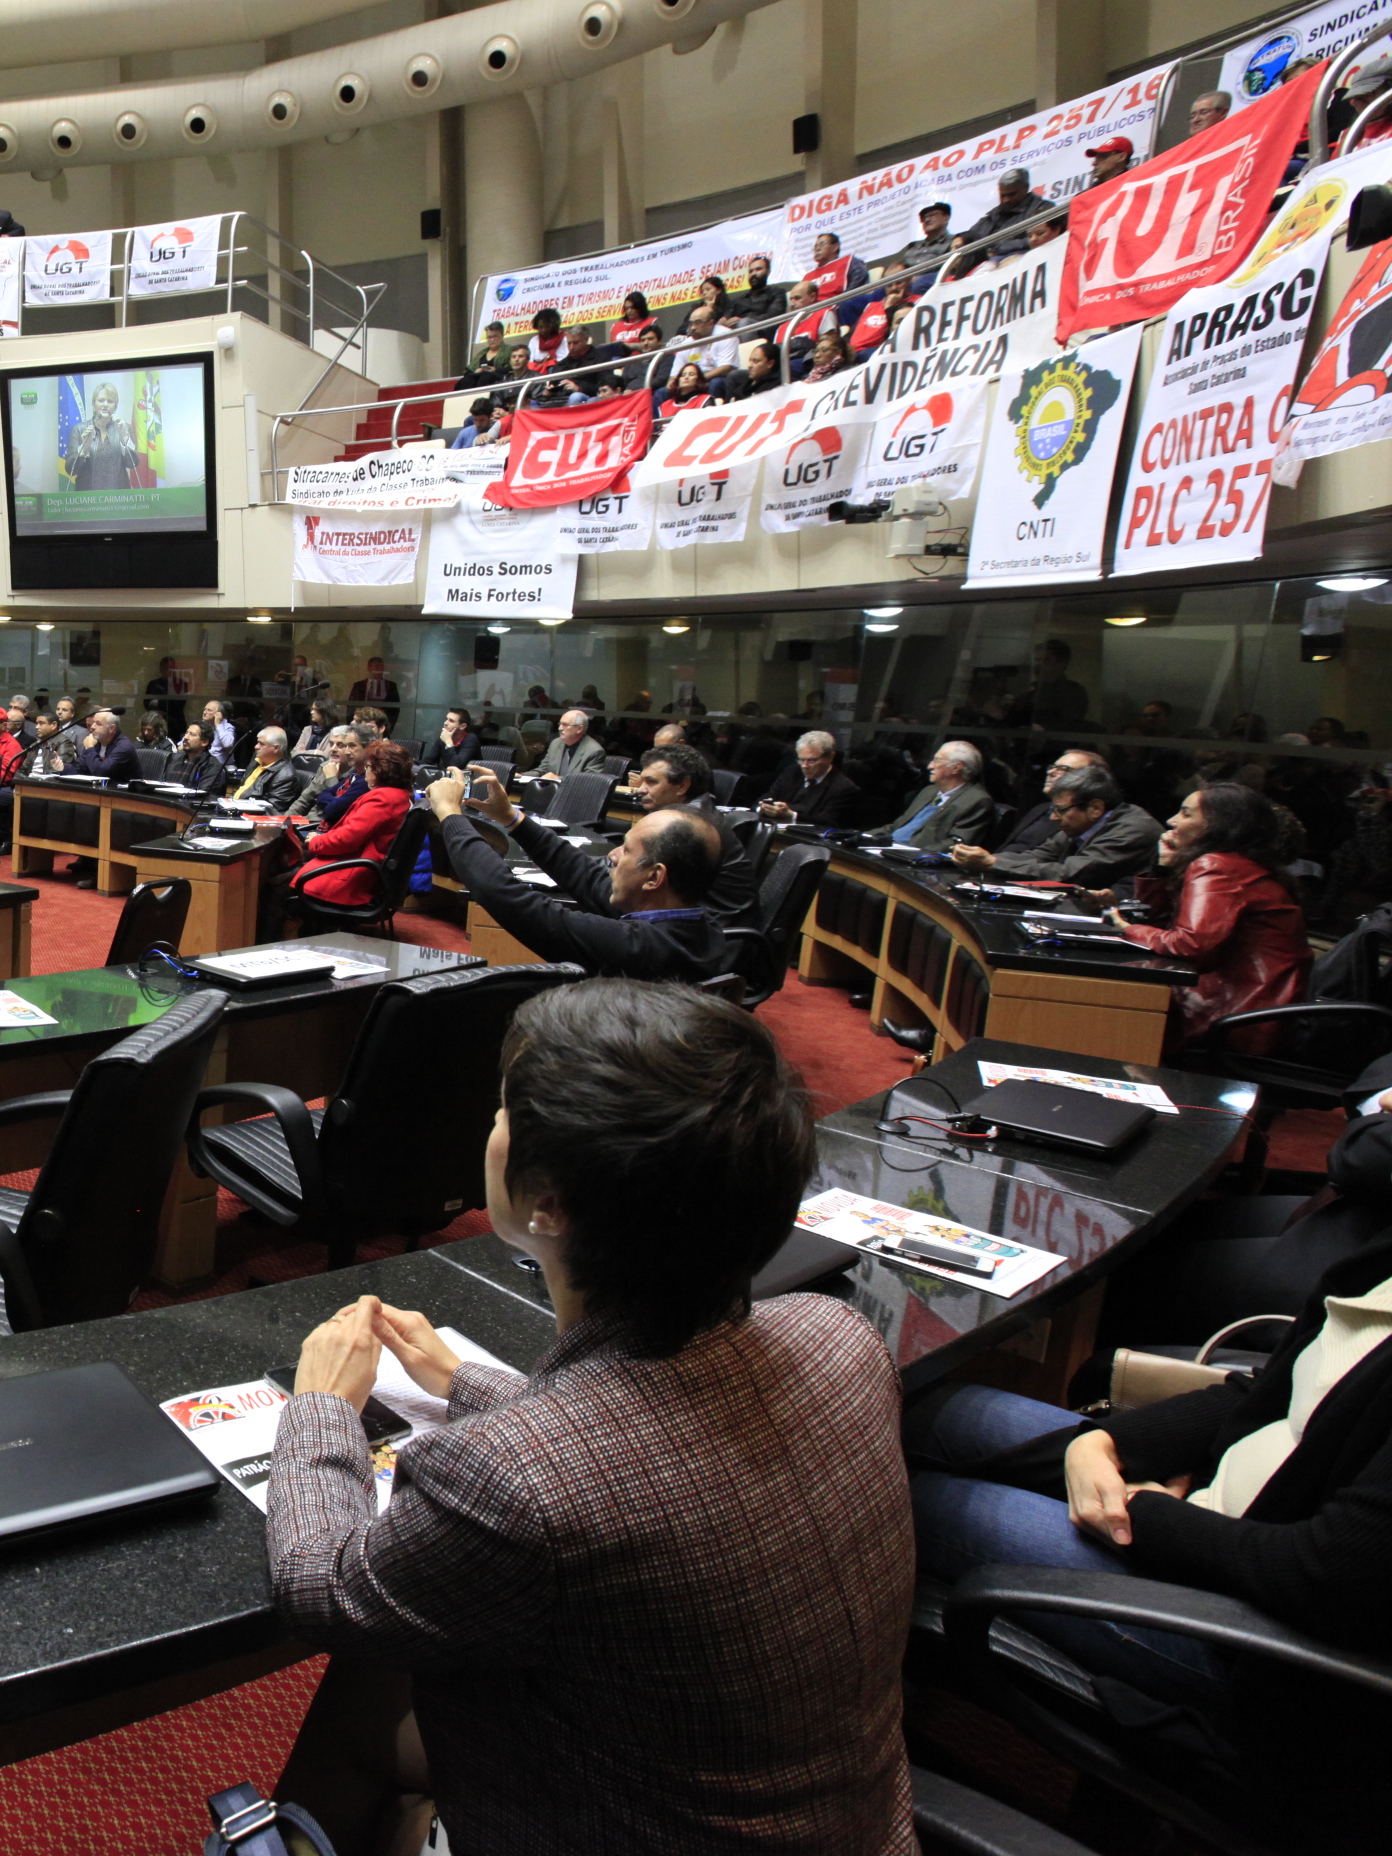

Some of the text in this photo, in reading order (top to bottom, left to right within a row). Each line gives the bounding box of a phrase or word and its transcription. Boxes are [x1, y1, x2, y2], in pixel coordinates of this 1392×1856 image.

[787, 73, 1166, 224] DIGA NÃO AO PLP 257/16
[790, 222, 812, 236] POR
[814, 214, 836, 231] QUE
[839, 207, 864, 222] ESTE
[866, 184, 911, 211] PROJETO
[957, 164, 986, 180] COM
[990, 158, 1006, 171] OS
[1010, 135, 1073, 167] SERVIÇOS
[1077, 107, 1156, 144] PÚBLICOS?
[149, 243, 193, 263] UGT
[562, 268, 578, 276] DOS
[579, 256, 645, 272] TRABALHADORES
[647, 252, 658, 260] EM
[660, 241, 693, 257] TURISMO
[44, 259, 89, 276] UGT
[492, 297, 560, 320] TRABALHADORES
[561, 295, 574, 310] EM
[576, 287, 616, 306] TURISMO
[618, 286, 624, 299] E
[669, 290, 688, 305] NAS
[1115, 286, 1136, 301] DOS
[576, 310, 593, 322] DOS
[912, 261, 1048, 351] REFORMA
[1166, 268, 1316, 367] APRASC
[1210, 347, 1239, 370] Praças
[1239, 342, 1253, 359] do
[1253, 330, 1292, 354] Estado
[663, 398, 808, 468] CUT
[1033, 423, 1068, 441] BRASIL
[1140, 395, 1256, 474] CONTRA
[521, 414, 639, 480] CUT RASIL
[883, 427, 947, 463] UGT
[783, 454, 840, 488] UGT
[291, 488, 331, 499] Sindicato
[379, 482, 409, 493] Classe
[553, 481, 567, 489] DOS
[65, 495, 97, 504] LUCIANE
[98, 493, 145, 503] CARMINATTI
[151, 493, 161, 502] PT
[578, 494, 630, 516] UGT
[1124, 458, 1272, 550] PLC 257
[319, 527, 416, 547] INTERSINDICAL
[1016, 517, 1056, 541] CNTI
[318, 545, 416, 557] Central da Classe Trabalhadora
[990, 551, 1092, 570] Secretaria da Região Sul
[443, 561, 553, 577] Unidos Somos
[446, 587, 543, 603] Mais Fortes!
